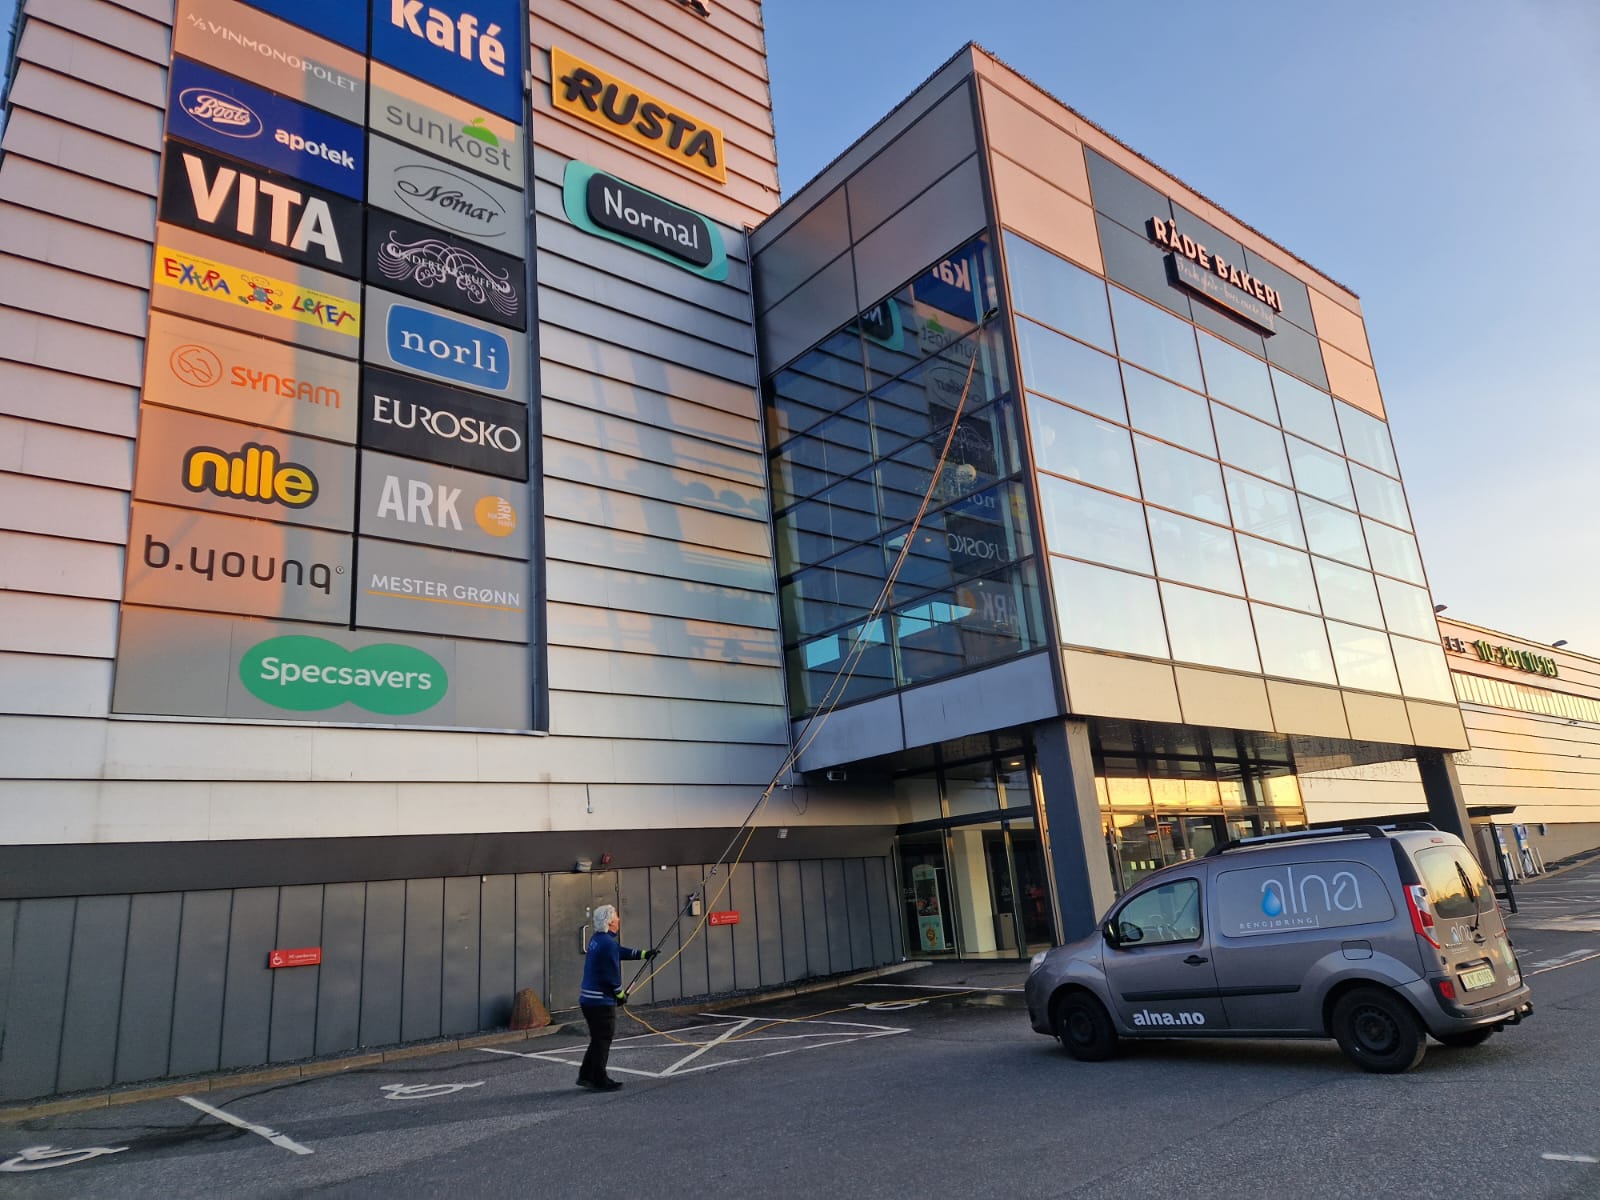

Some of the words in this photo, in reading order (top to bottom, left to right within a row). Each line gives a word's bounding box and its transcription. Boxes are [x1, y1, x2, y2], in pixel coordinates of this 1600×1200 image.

[208, 21, 358, 93] VINMONOPOLET
[391, 0, 505, 76] kafé
[189, 95, 250, 126] Boots
[386, 105, 511, 171] sunkost
[560, 67, 717, 168] RUSTA
[274, 128, 355, 170] apotek
[182, 152, 344, 264] VITA
[397, 180, 499, 224] Nomar
[603, 186, 698, 249] Normal
[1150, 216, 1211, 270] RÅDE
[1213, 254, 1283, 312] BAKERI
[400, 330, 499, 374] norli
[231, 366, 341, 409] SYNSAM
[373, 394, 521, 453] EUROSKO
[184, 443, 318, 508] nille
[376, 475, 463, 531] ARK
[371, 574, 448, 597] MESTER
[453, 585, 520, 606] GRØNN
[260, 656, 432, 691] Specsavers
[1261, 867, 1363, 917] alna
[1133, 1009, 1206, 1026] alna.no
